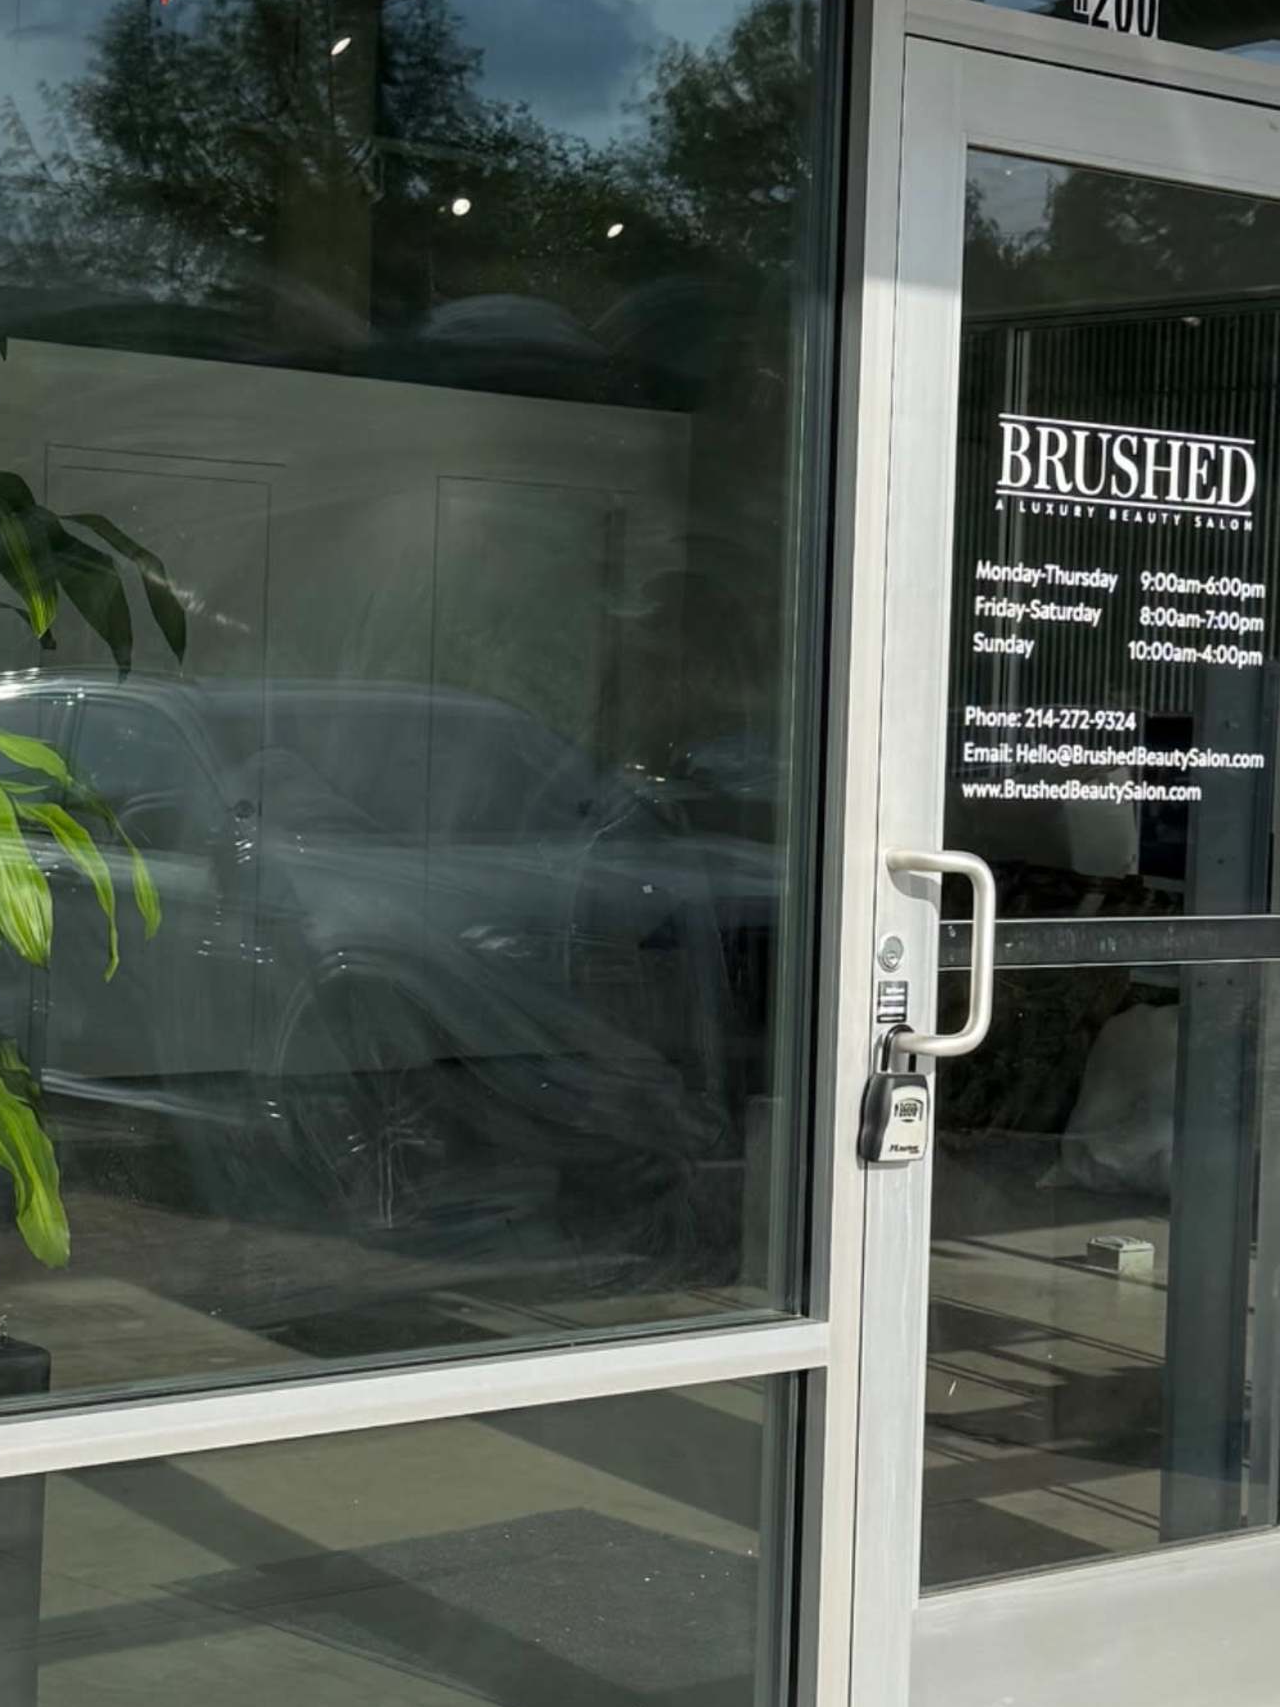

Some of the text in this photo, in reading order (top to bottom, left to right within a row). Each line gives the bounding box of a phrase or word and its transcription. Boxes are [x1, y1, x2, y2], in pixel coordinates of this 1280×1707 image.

[997, 422, 1256, 507] BRUSHED
[1019, 502, 1095, 518] LUXURY
[1110, 508, 1182, 525] BEAUTY
[1195, 516, 1252, 531] SALON
[976, 560, 1266, 599] Monday-Thursday 9:00am-6:00pm
[974, 596, 1265, 633] Friday-Saturday 8:00am-7:00pm
[973, 633, 1263, 668] Sunday 10:00am-4:00pm
[965, 706, 1137, 731] Phone: 214-272-9324
[963, 743, 1264, 770] Email: Hello@BrushedBeautySalon.com
[962, 780, 1201, 805] www.BrushedBeautySalon.com
